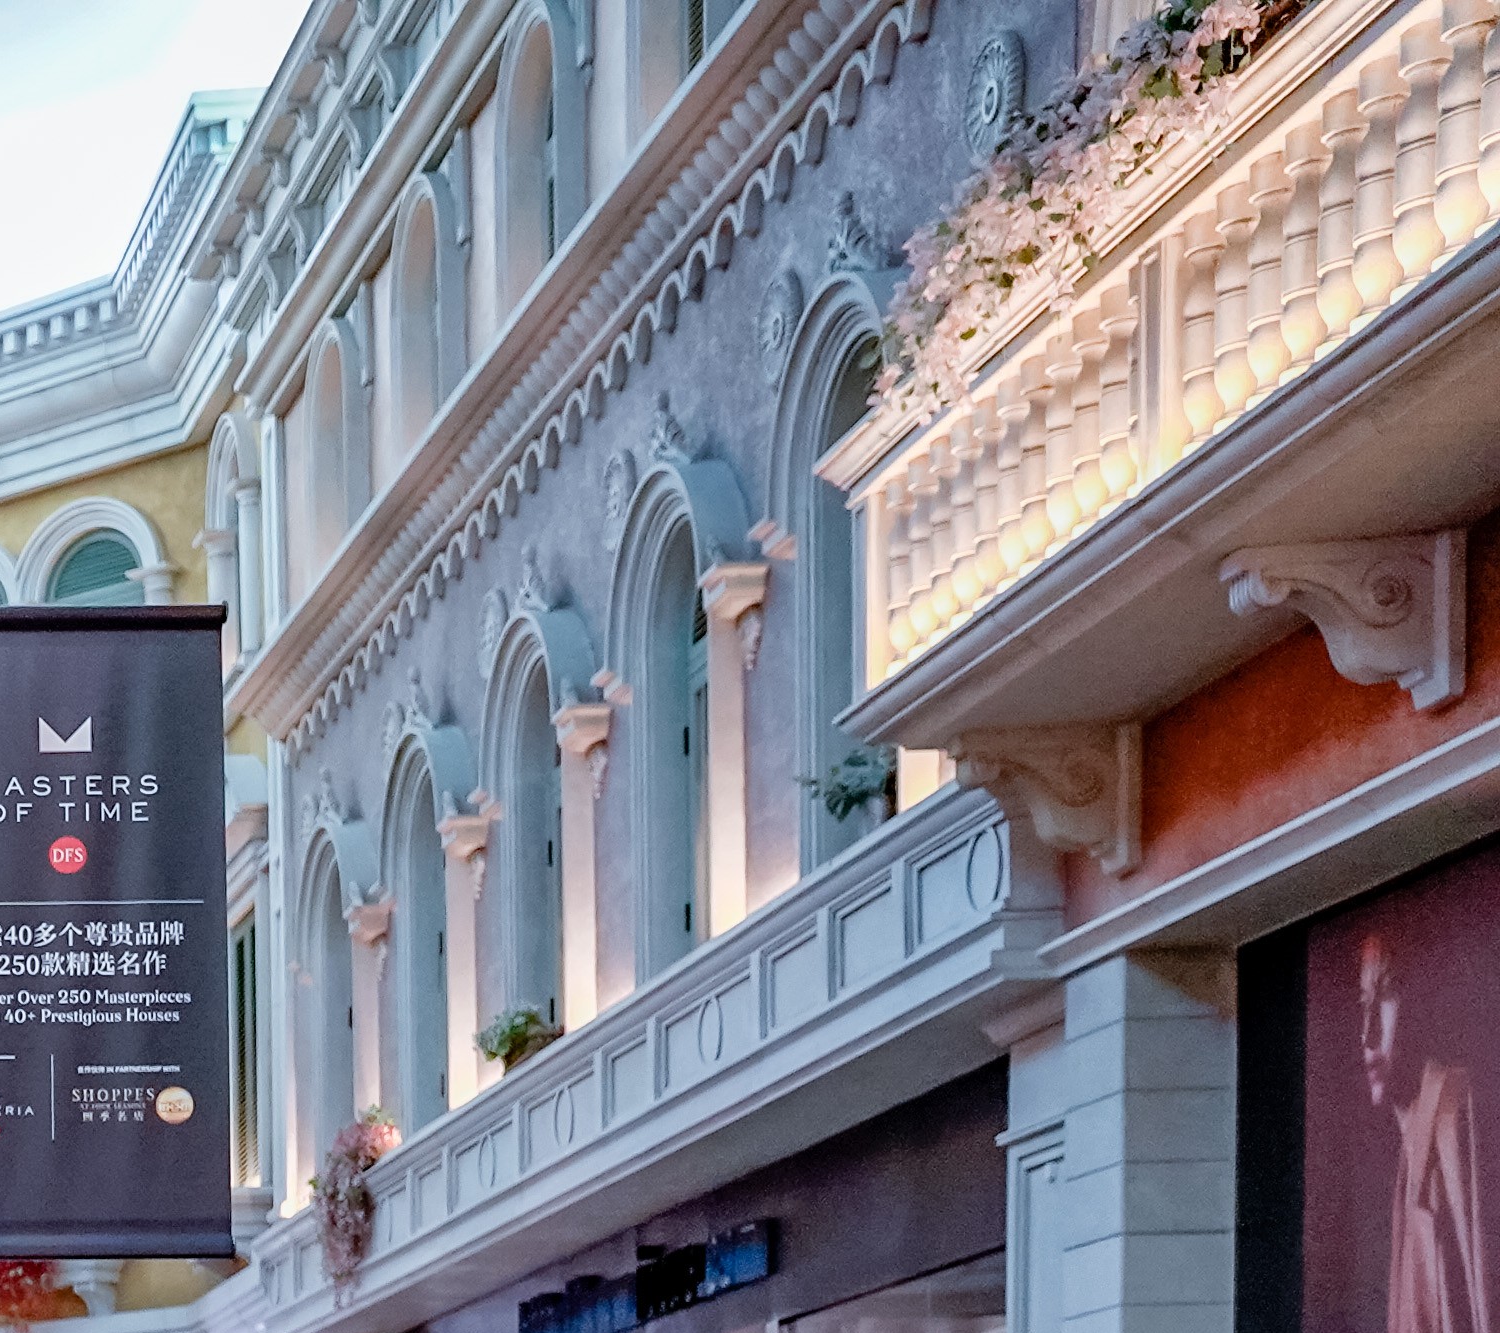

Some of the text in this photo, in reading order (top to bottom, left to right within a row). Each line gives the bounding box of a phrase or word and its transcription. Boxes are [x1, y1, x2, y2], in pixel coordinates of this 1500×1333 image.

[58, 801, 150, 822] TIME
[52, 847, 84, 864] DFS
[17, 990, 54, 1004] Over
[57, 989, 91, 1004] 250
[95, 988, 192, 1007] Masterpieces
[4, 1008, 36, 1023] 40+
[40, 1007, 122, 1026] Prestigious
[126, 1007, 180, 1022] Houses
[71, 1087, 155, 1102] SHOPPES
